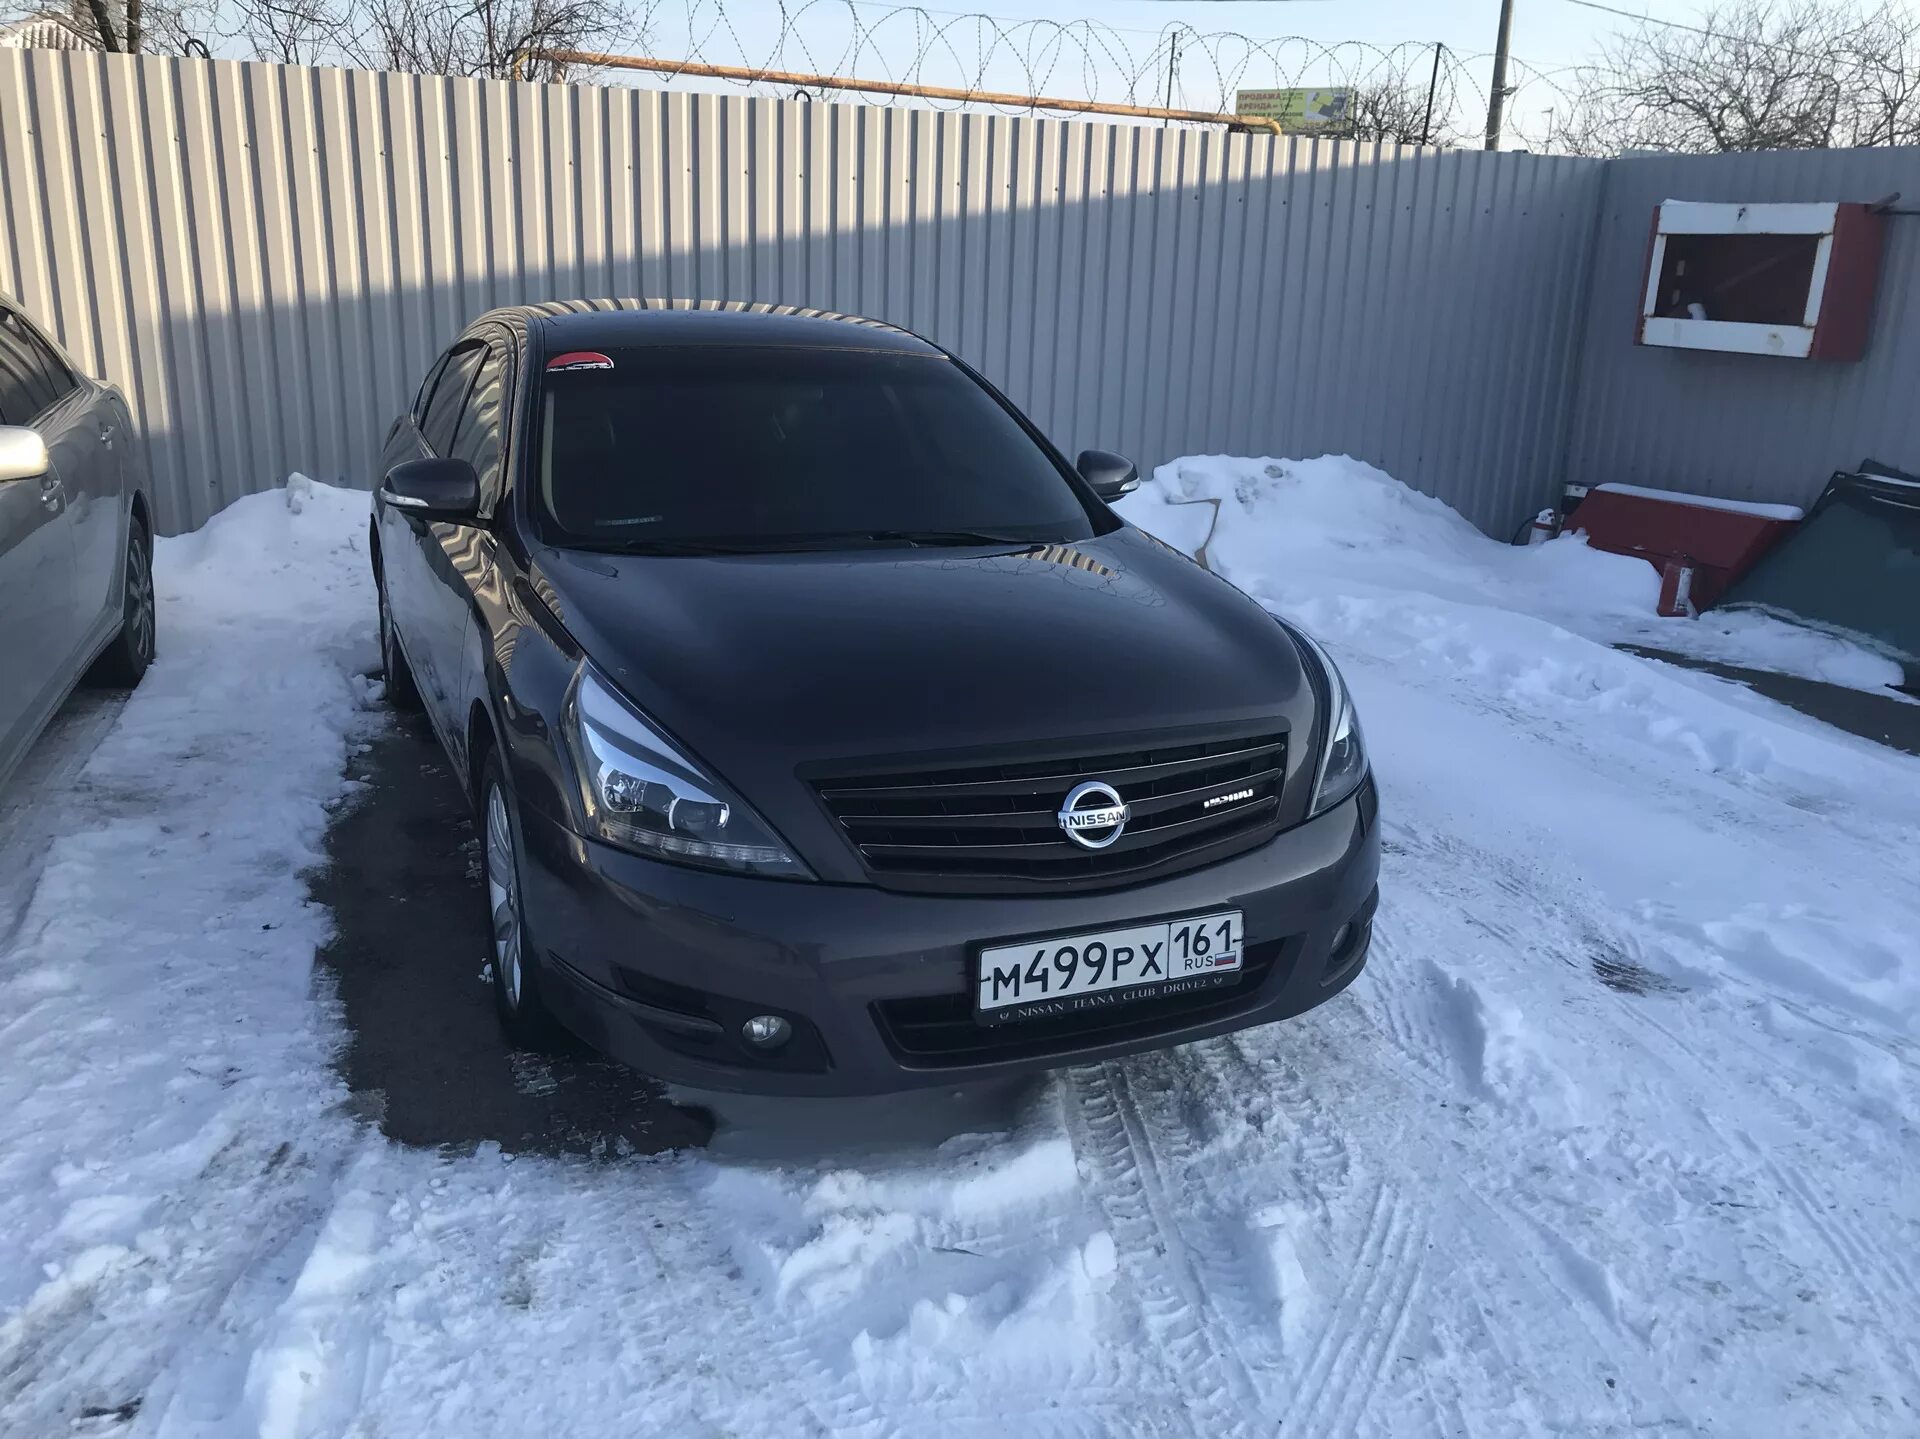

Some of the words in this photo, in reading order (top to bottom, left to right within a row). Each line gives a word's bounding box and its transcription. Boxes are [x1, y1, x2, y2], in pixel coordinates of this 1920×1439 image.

[1239, 92, 1280, 100] ПРОДАЖА
[1068, 810, 1126, 826] NISSAN
[1174, 919, 1231, 958] 161
[1184, 955, 1213, 971] RUS
[1018, 1002, 1064, 1018] NISSAN
[1072, 994, 1115, 1009] TEANA
[1123, 987, 1156, 1000] CLUB
[1163, 979, 1207, 994] DRIVE2
